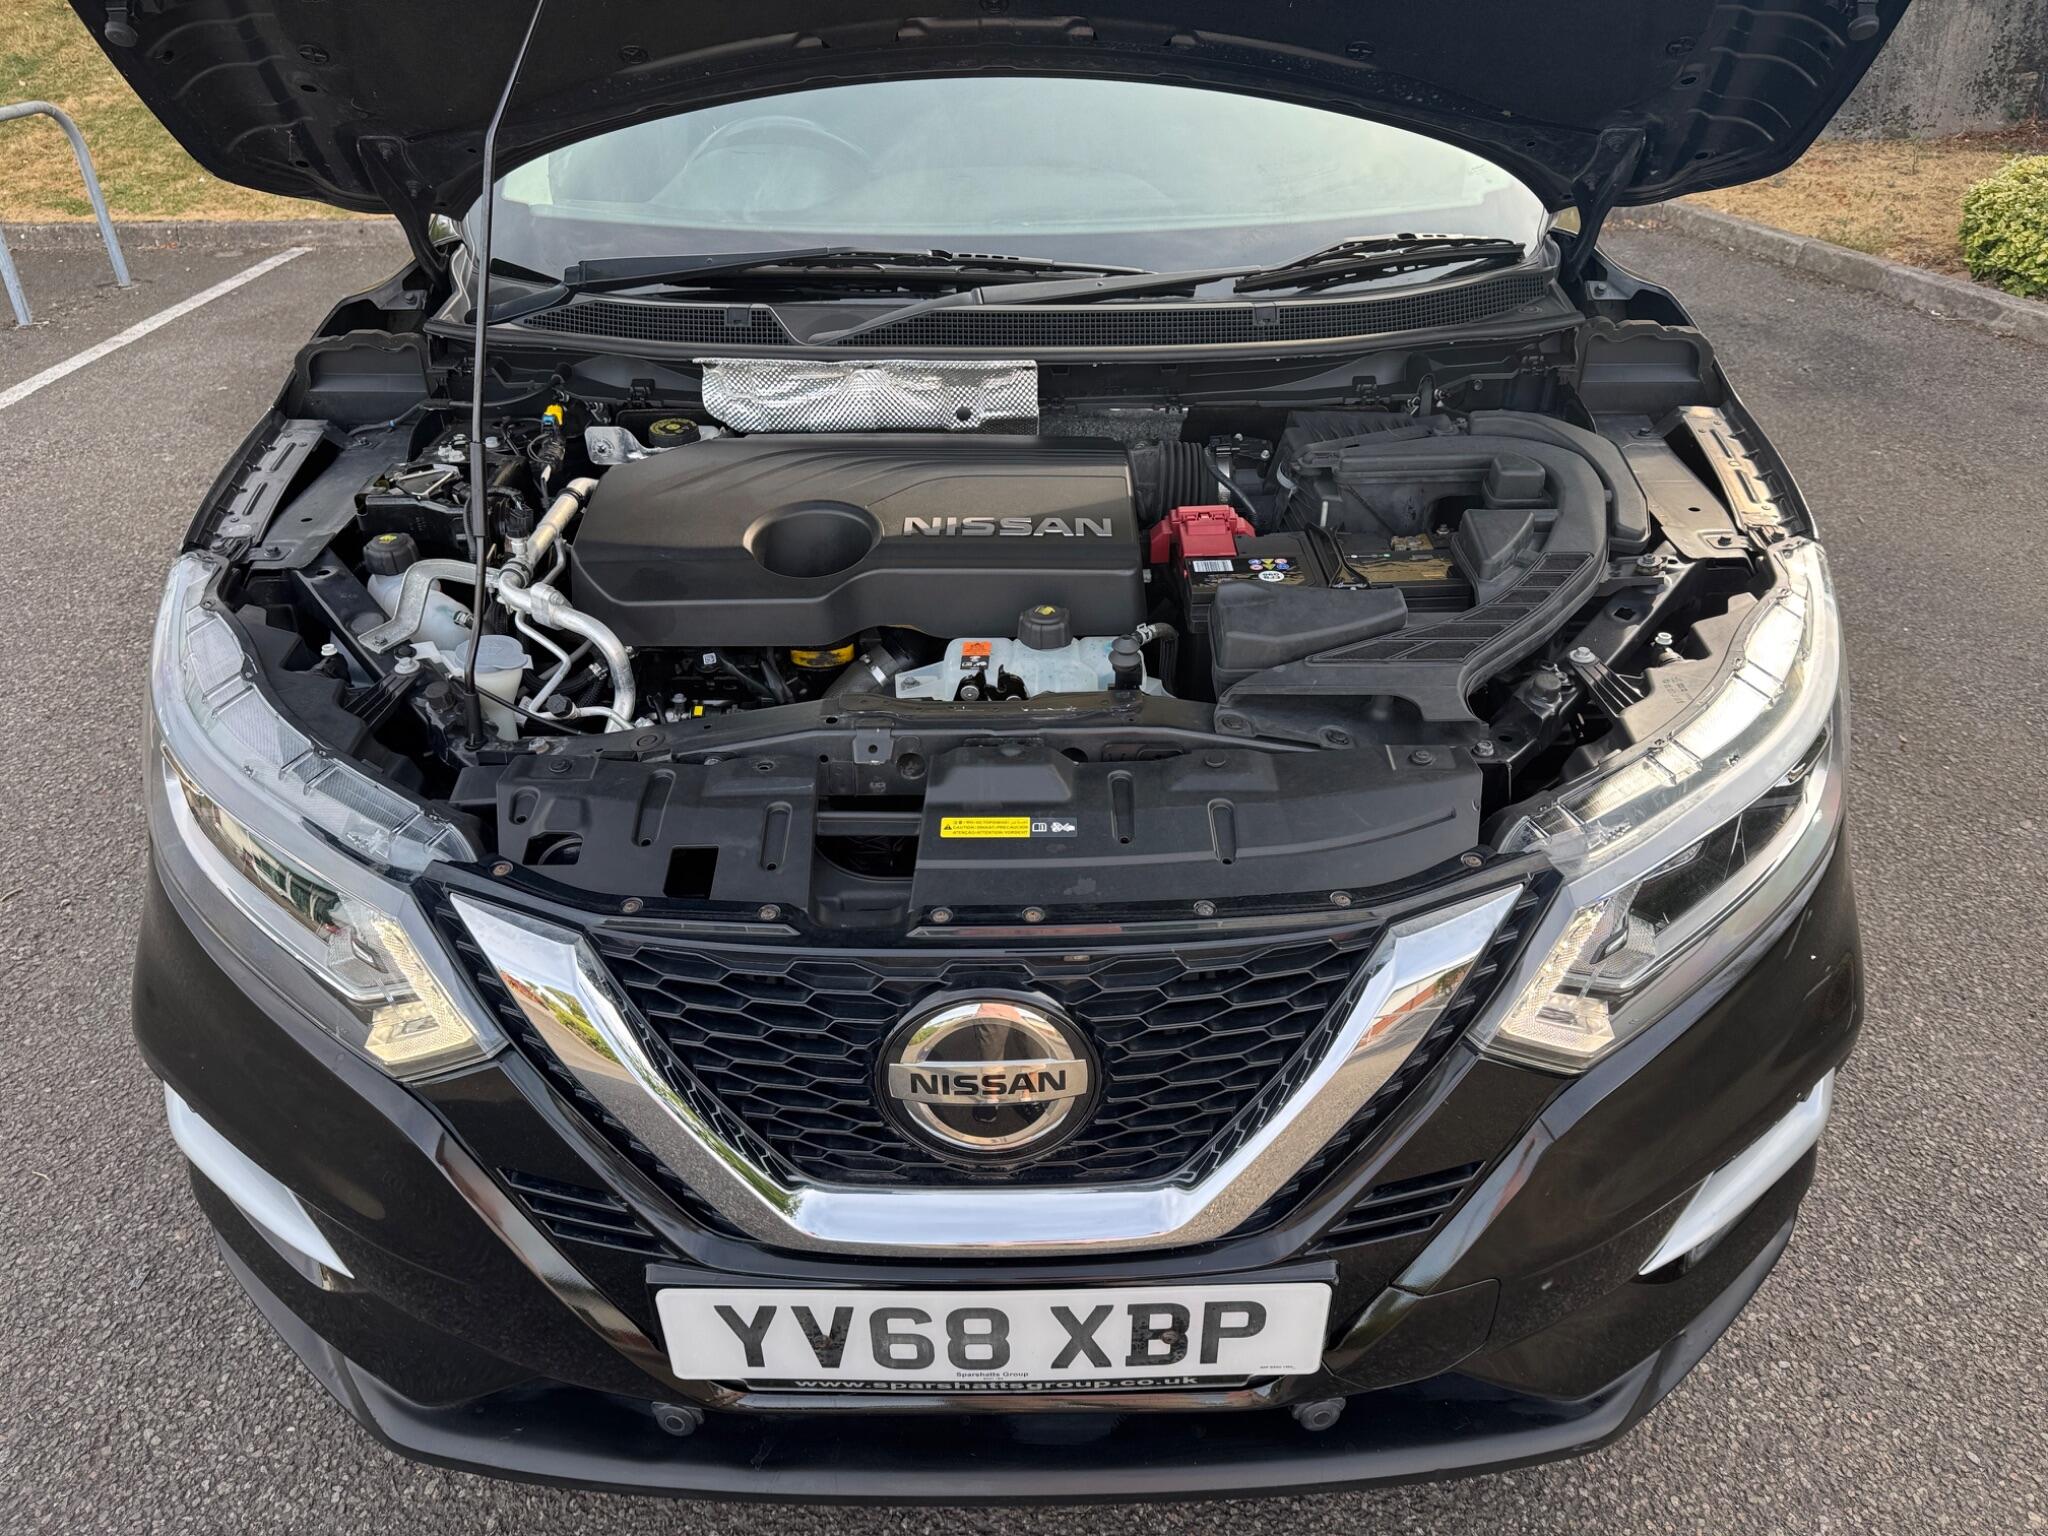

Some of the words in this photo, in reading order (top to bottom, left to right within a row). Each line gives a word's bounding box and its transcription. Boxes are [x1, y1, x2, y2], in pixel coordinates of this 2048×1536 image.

[903, 517, 1113, 537] NISSAN
[910, 1070, 1066, 1095] NISSAN
[713, 1304, 1010, 1370] YV68
[1050, 1300, 1267, 1369] XBP
[794, 1376, 1199, 1391] www.sparshattsgroup.co.uk
